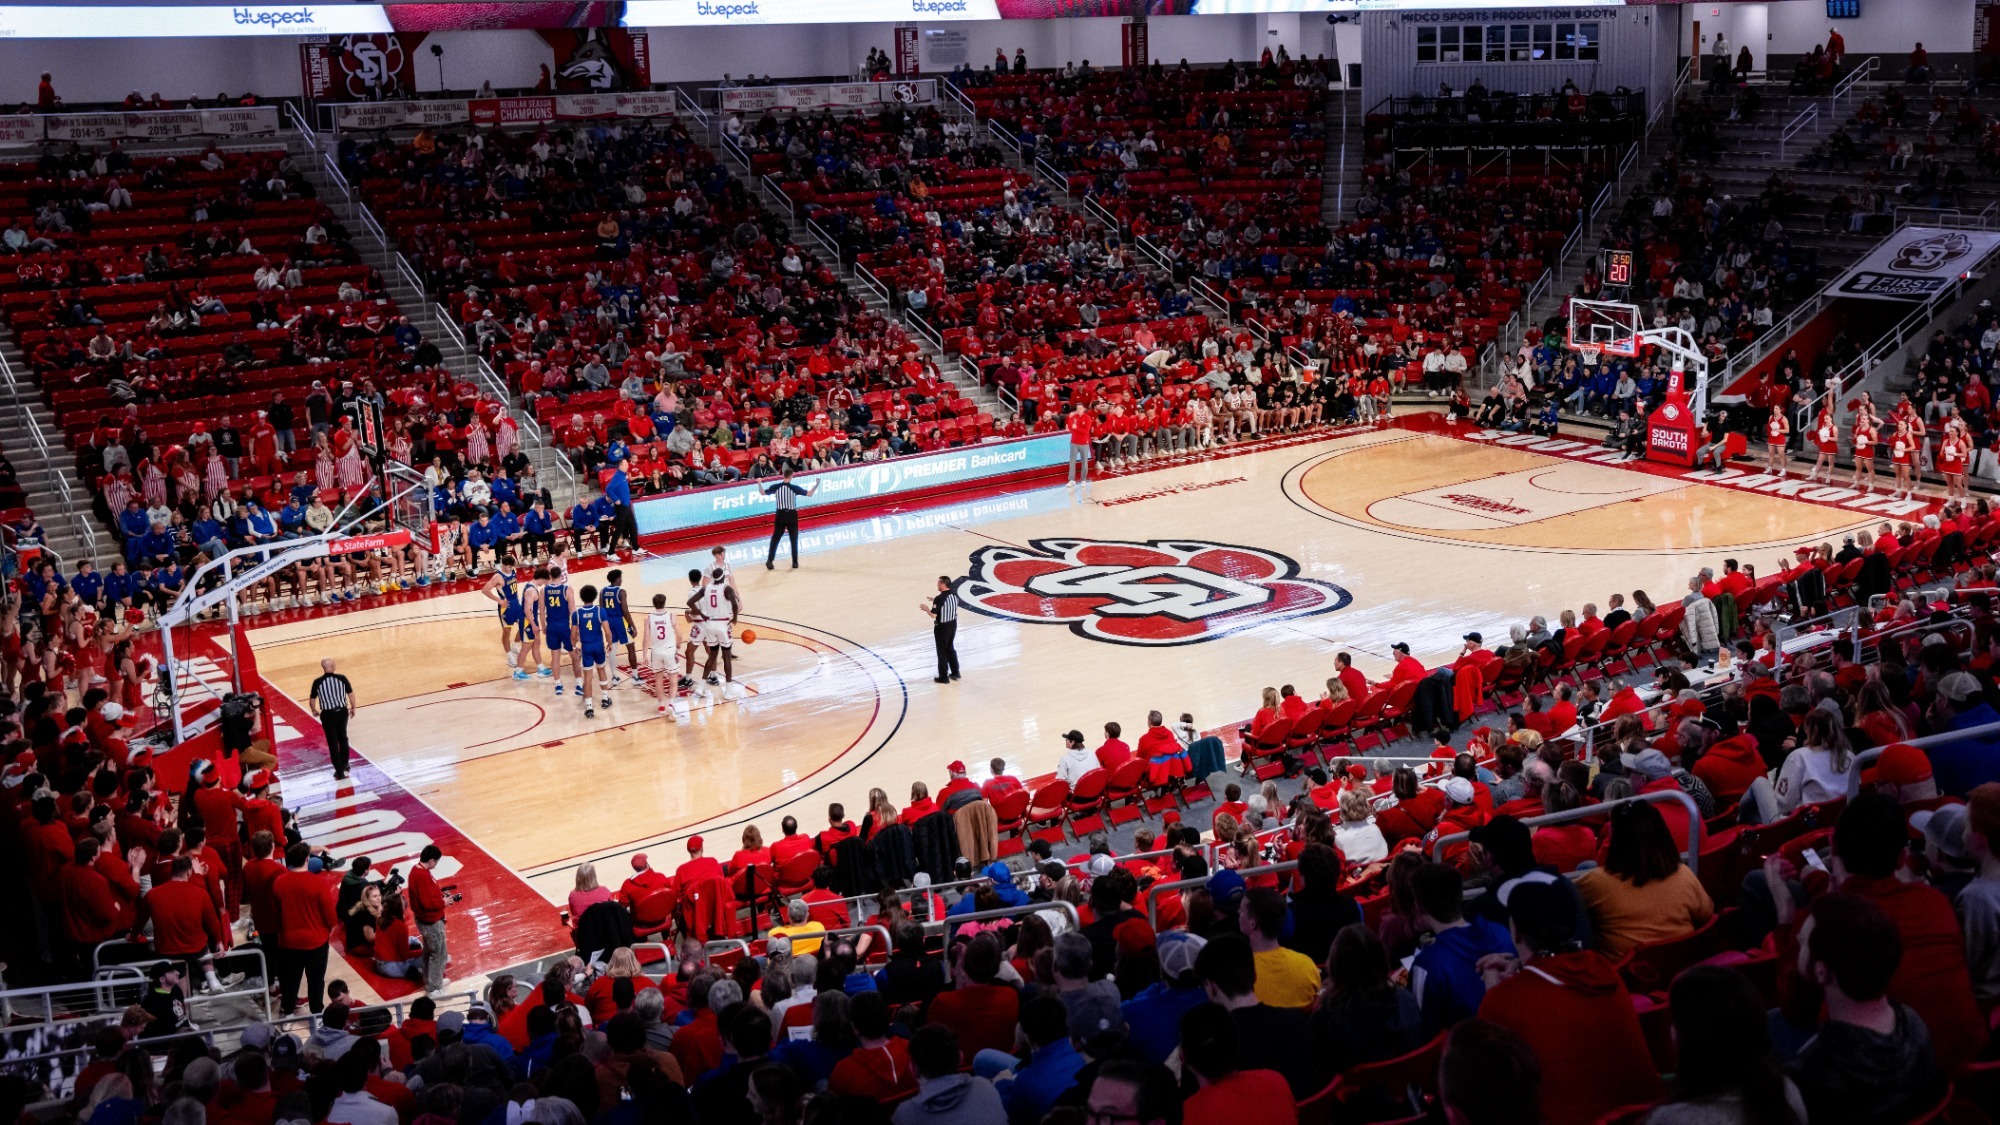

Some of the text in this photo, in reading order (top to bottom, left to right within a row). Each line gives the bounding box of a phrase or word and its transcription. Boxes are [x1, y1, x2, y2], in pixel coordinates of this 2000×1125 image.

[697, 1, 760, 19] bluepeak
[912, 0, 967, 15] bluepeak
[233, 7, 314, 29] bluepeak
[1401, 9, 1617, 21] MIDCO SPORTS PRODUCTION BOOTH
[309, 48, 324, 98] BASKETBALL
[433, 103, 466, 112] BASKETBALL
[500, 99, 552, 108] REGULAR SEASON
[363, 106, 398, 115] BASKETBALL
[500, 107, 552, 120] CHAMPIONS
[579, 106, 594, 114] 2019
[49, 117, 122, 127] WOMEN'S BASKETBALL
[128, 115, 198, 126] WOMEN'S BASKETBALL
[218, 112, 257, 121] VOLLEYBALL
[358, 116, 386, 126] 2016-17
[70, 127, 105, 138] 2014-15
[148, 125, 182, 135] 2015-16
[230, 122, 248, 132] 2016
[1610, 264, 1627, 282] 20
[1876, 277, 1939, 289] FIRST
[1868, 285, 1928, 295] DAKOTA
[1651, 428, 1688, 443] SOUTH
[1651, 437, 1687, 451] DAKOTA
[713, 494, 745, 511] First
[821, 476, 854, 493] Bank
[903, 456, 967, 480] PREMIER
[971, 447, 1027, 468] Bankcard
[1680, 467, 1930, 516] DAKOTA
[548, 596, 561, 607] 34
[605, 598, 615, 609] 14
[710, 594, 718, 608] 0
[586, 619, 594, 631] 4
[656, 625, 666, 640] 3
